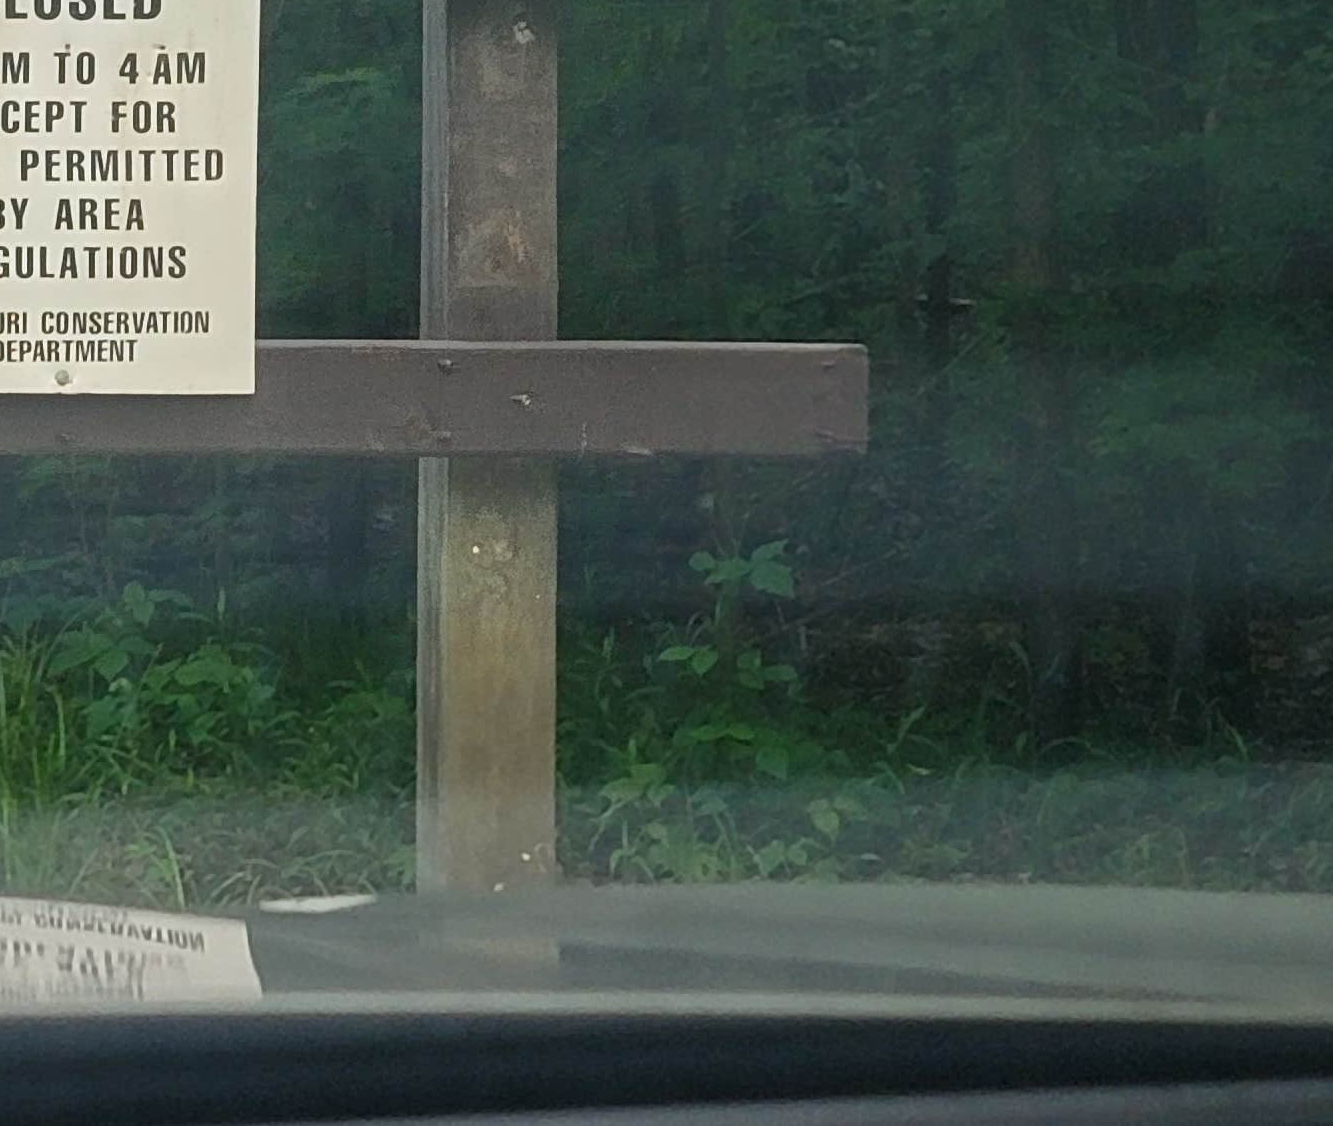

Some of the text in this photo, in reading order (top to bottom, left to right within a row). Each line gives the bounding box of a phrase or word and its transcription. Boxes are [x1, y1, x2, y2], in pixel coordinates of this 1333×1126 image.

[53, 51, 96, 85] TO
[118, 52, 140, 85] 4
[152, 51, 206, 85] AM
[111, 100, 176, 134] FOR
[20, 148, 224, 182] PERMITTED
[54, 198, 145, 231] AREA
[41, 310, 210, 335] CONSERVATION
